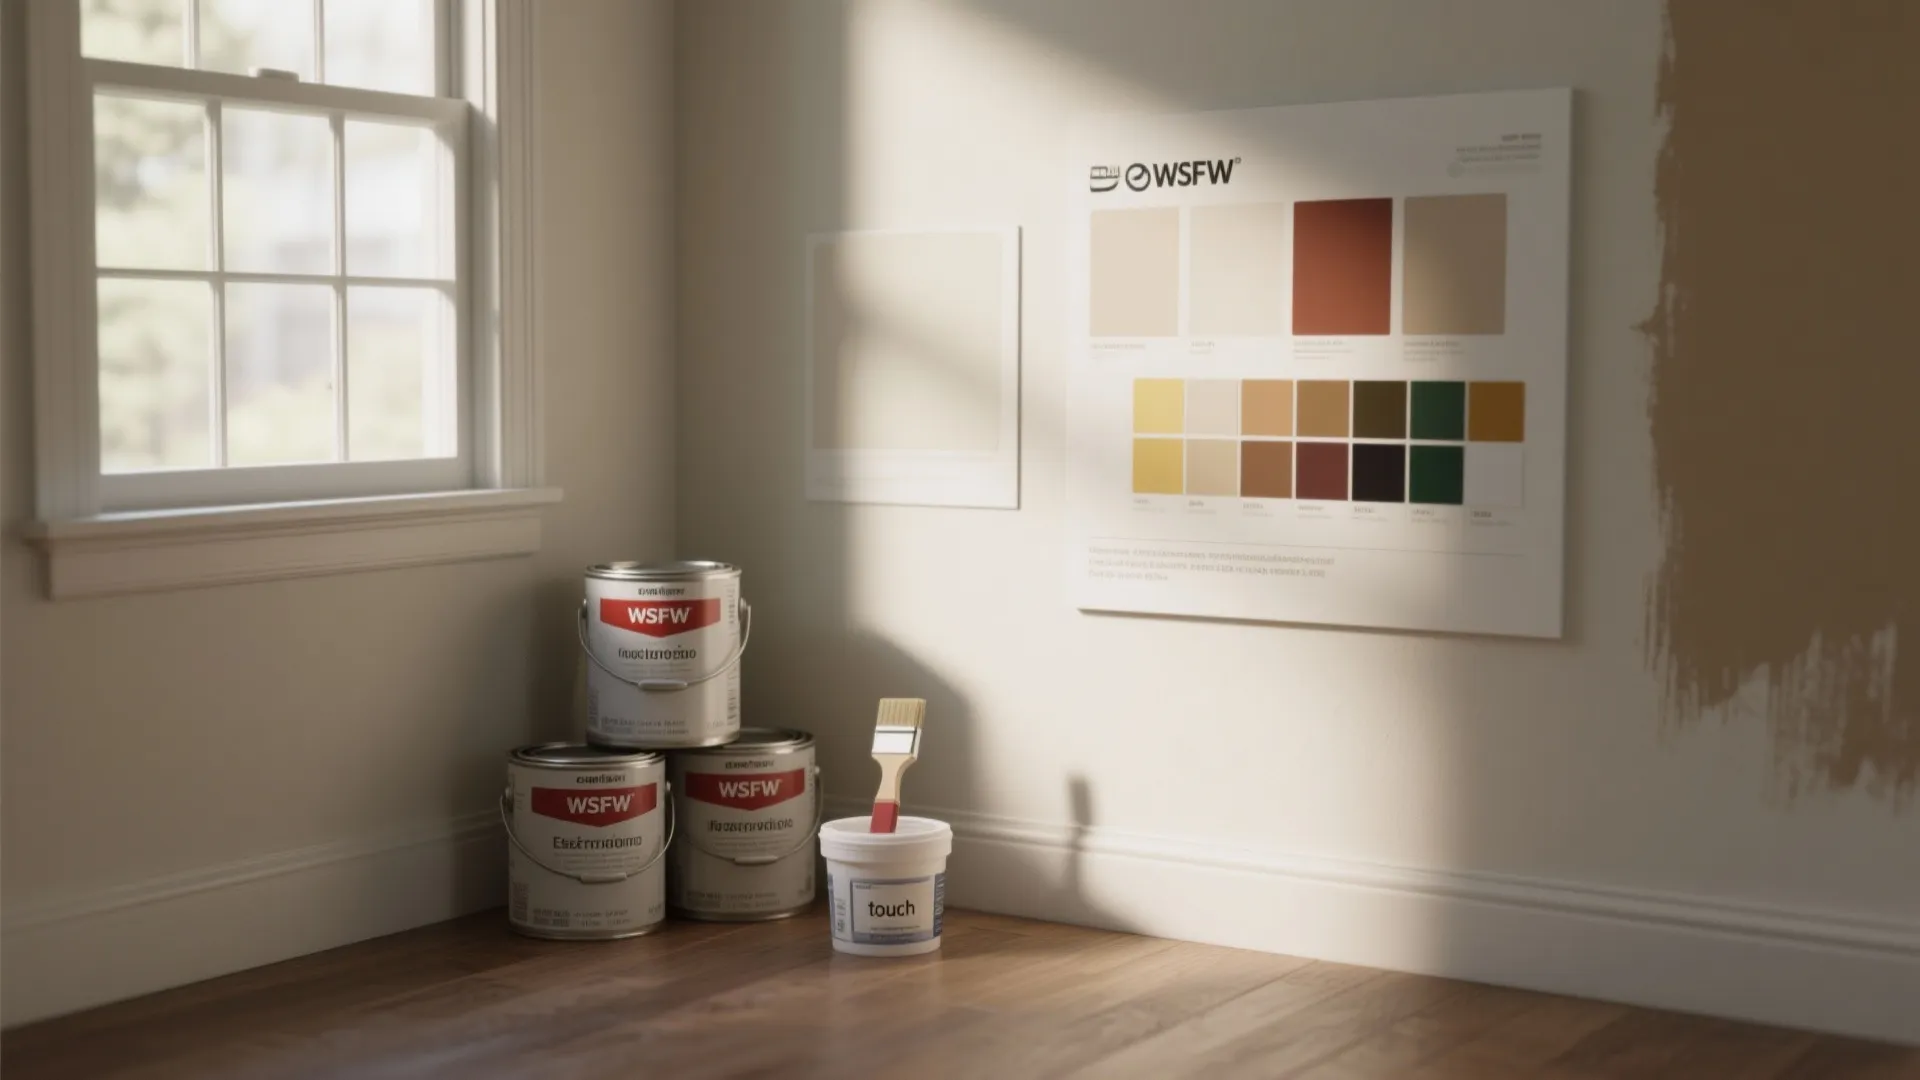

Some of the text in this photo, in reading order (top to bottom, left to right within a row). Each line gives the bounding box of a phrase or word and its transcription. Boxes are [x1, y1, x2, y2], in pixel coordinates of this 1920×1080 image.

[1152, 159, 1234, 188] WSFW
[627, 607, 690, 625] WSFW
[718, 779, 780, 798] WSFW
[566, 794, 631, 814] WSFW
[868, 899, 915, 918] touch
